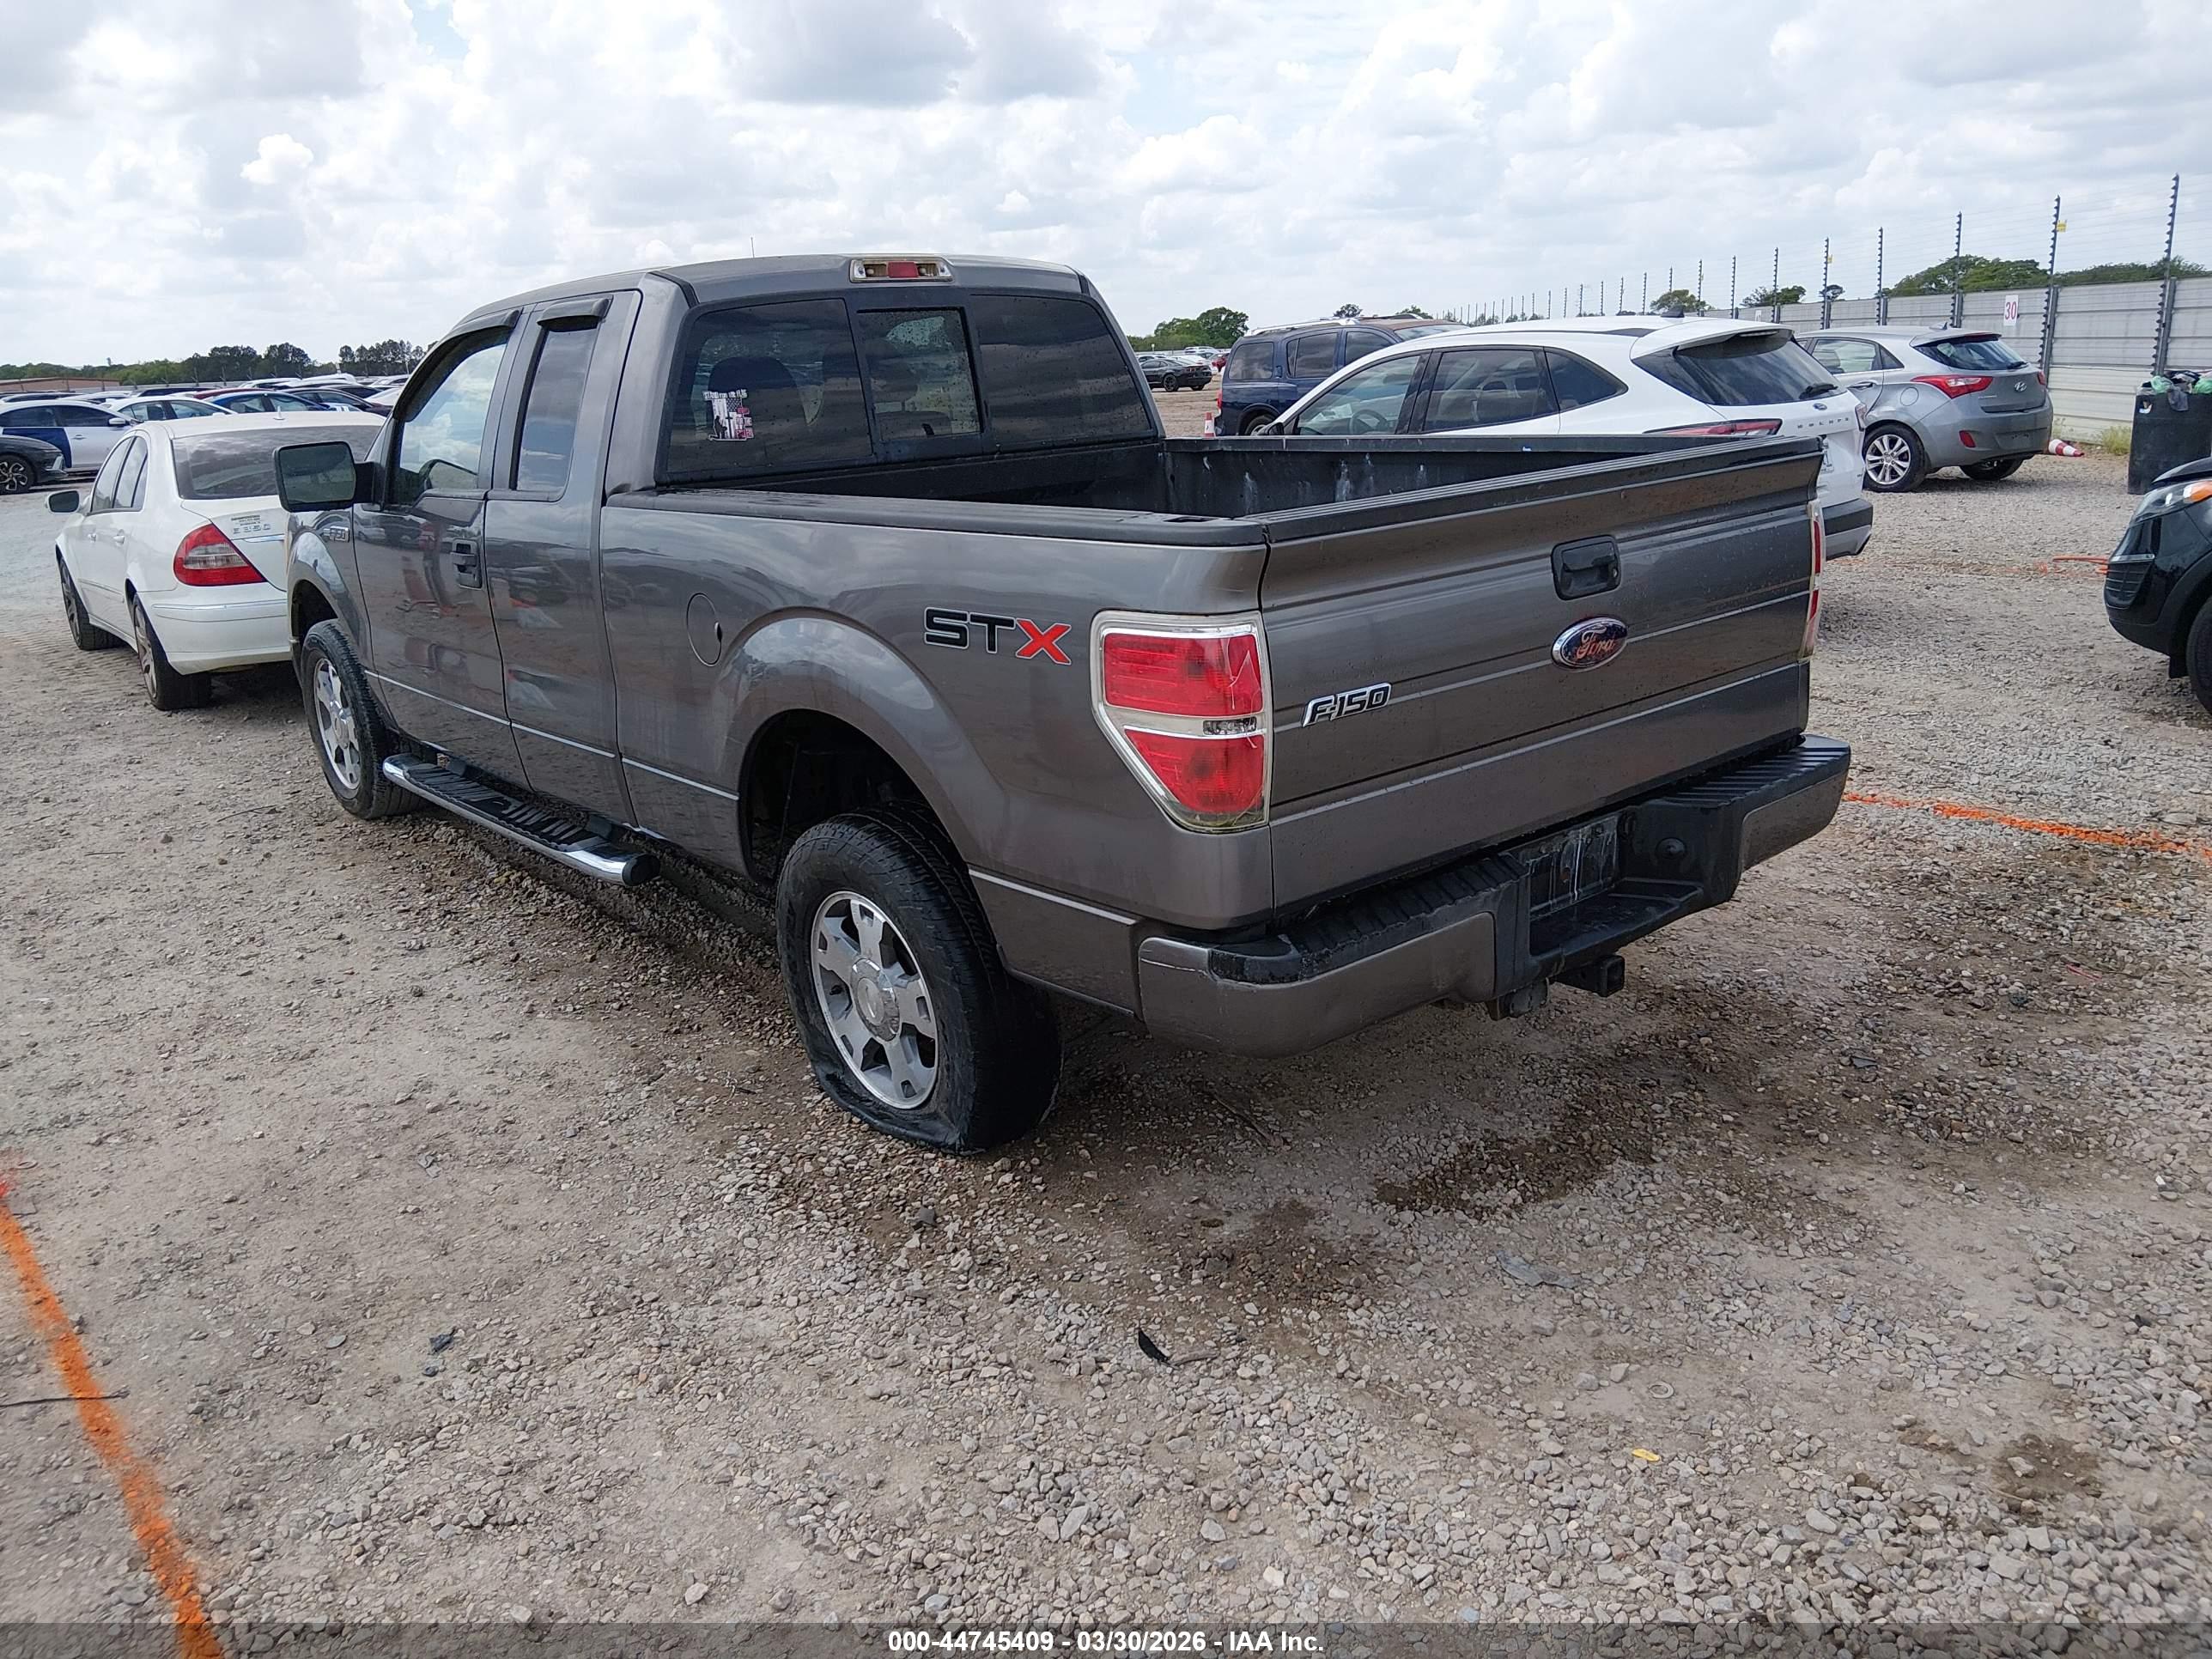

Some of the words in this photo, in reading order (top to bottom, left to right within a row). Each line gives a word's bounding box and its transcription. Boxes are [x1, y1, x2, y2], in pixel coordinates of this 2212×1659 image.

[2005, 301, 2017, 319] 30
[924, 606, 1072, 665] STX
[1576, 623, 1616, 659] Ford
